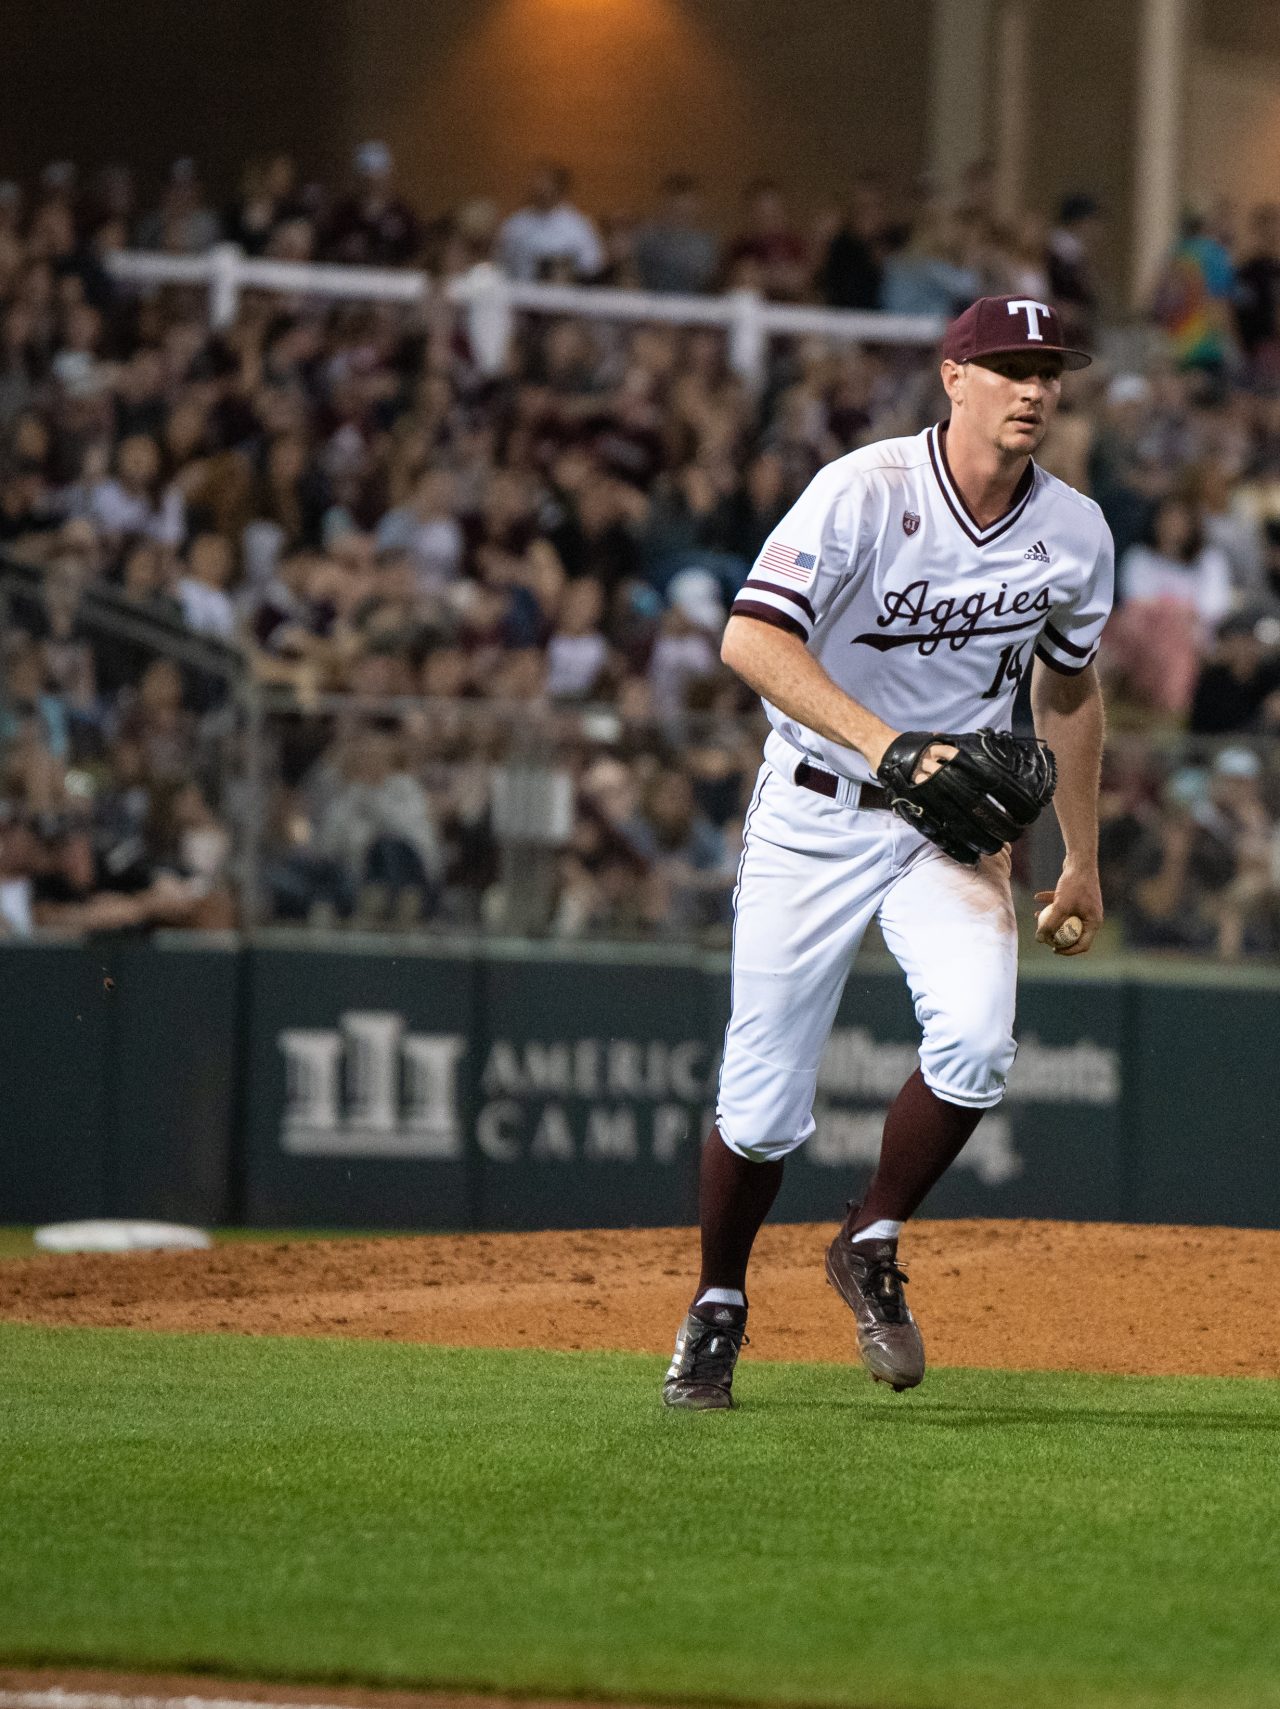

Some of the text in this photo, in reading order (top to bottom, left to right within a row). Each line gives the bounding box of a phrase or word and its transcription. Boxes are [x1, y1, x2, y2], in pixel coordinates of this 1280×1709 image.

[1006, 299, 1051, 341] T
[1023, 551, 1051, 564] adidas
[876, 579, 1052, 656] Aggies
[480, 1039, 722, 1098] AMERIC
[475, 1100, 716, 1162] CAMP
